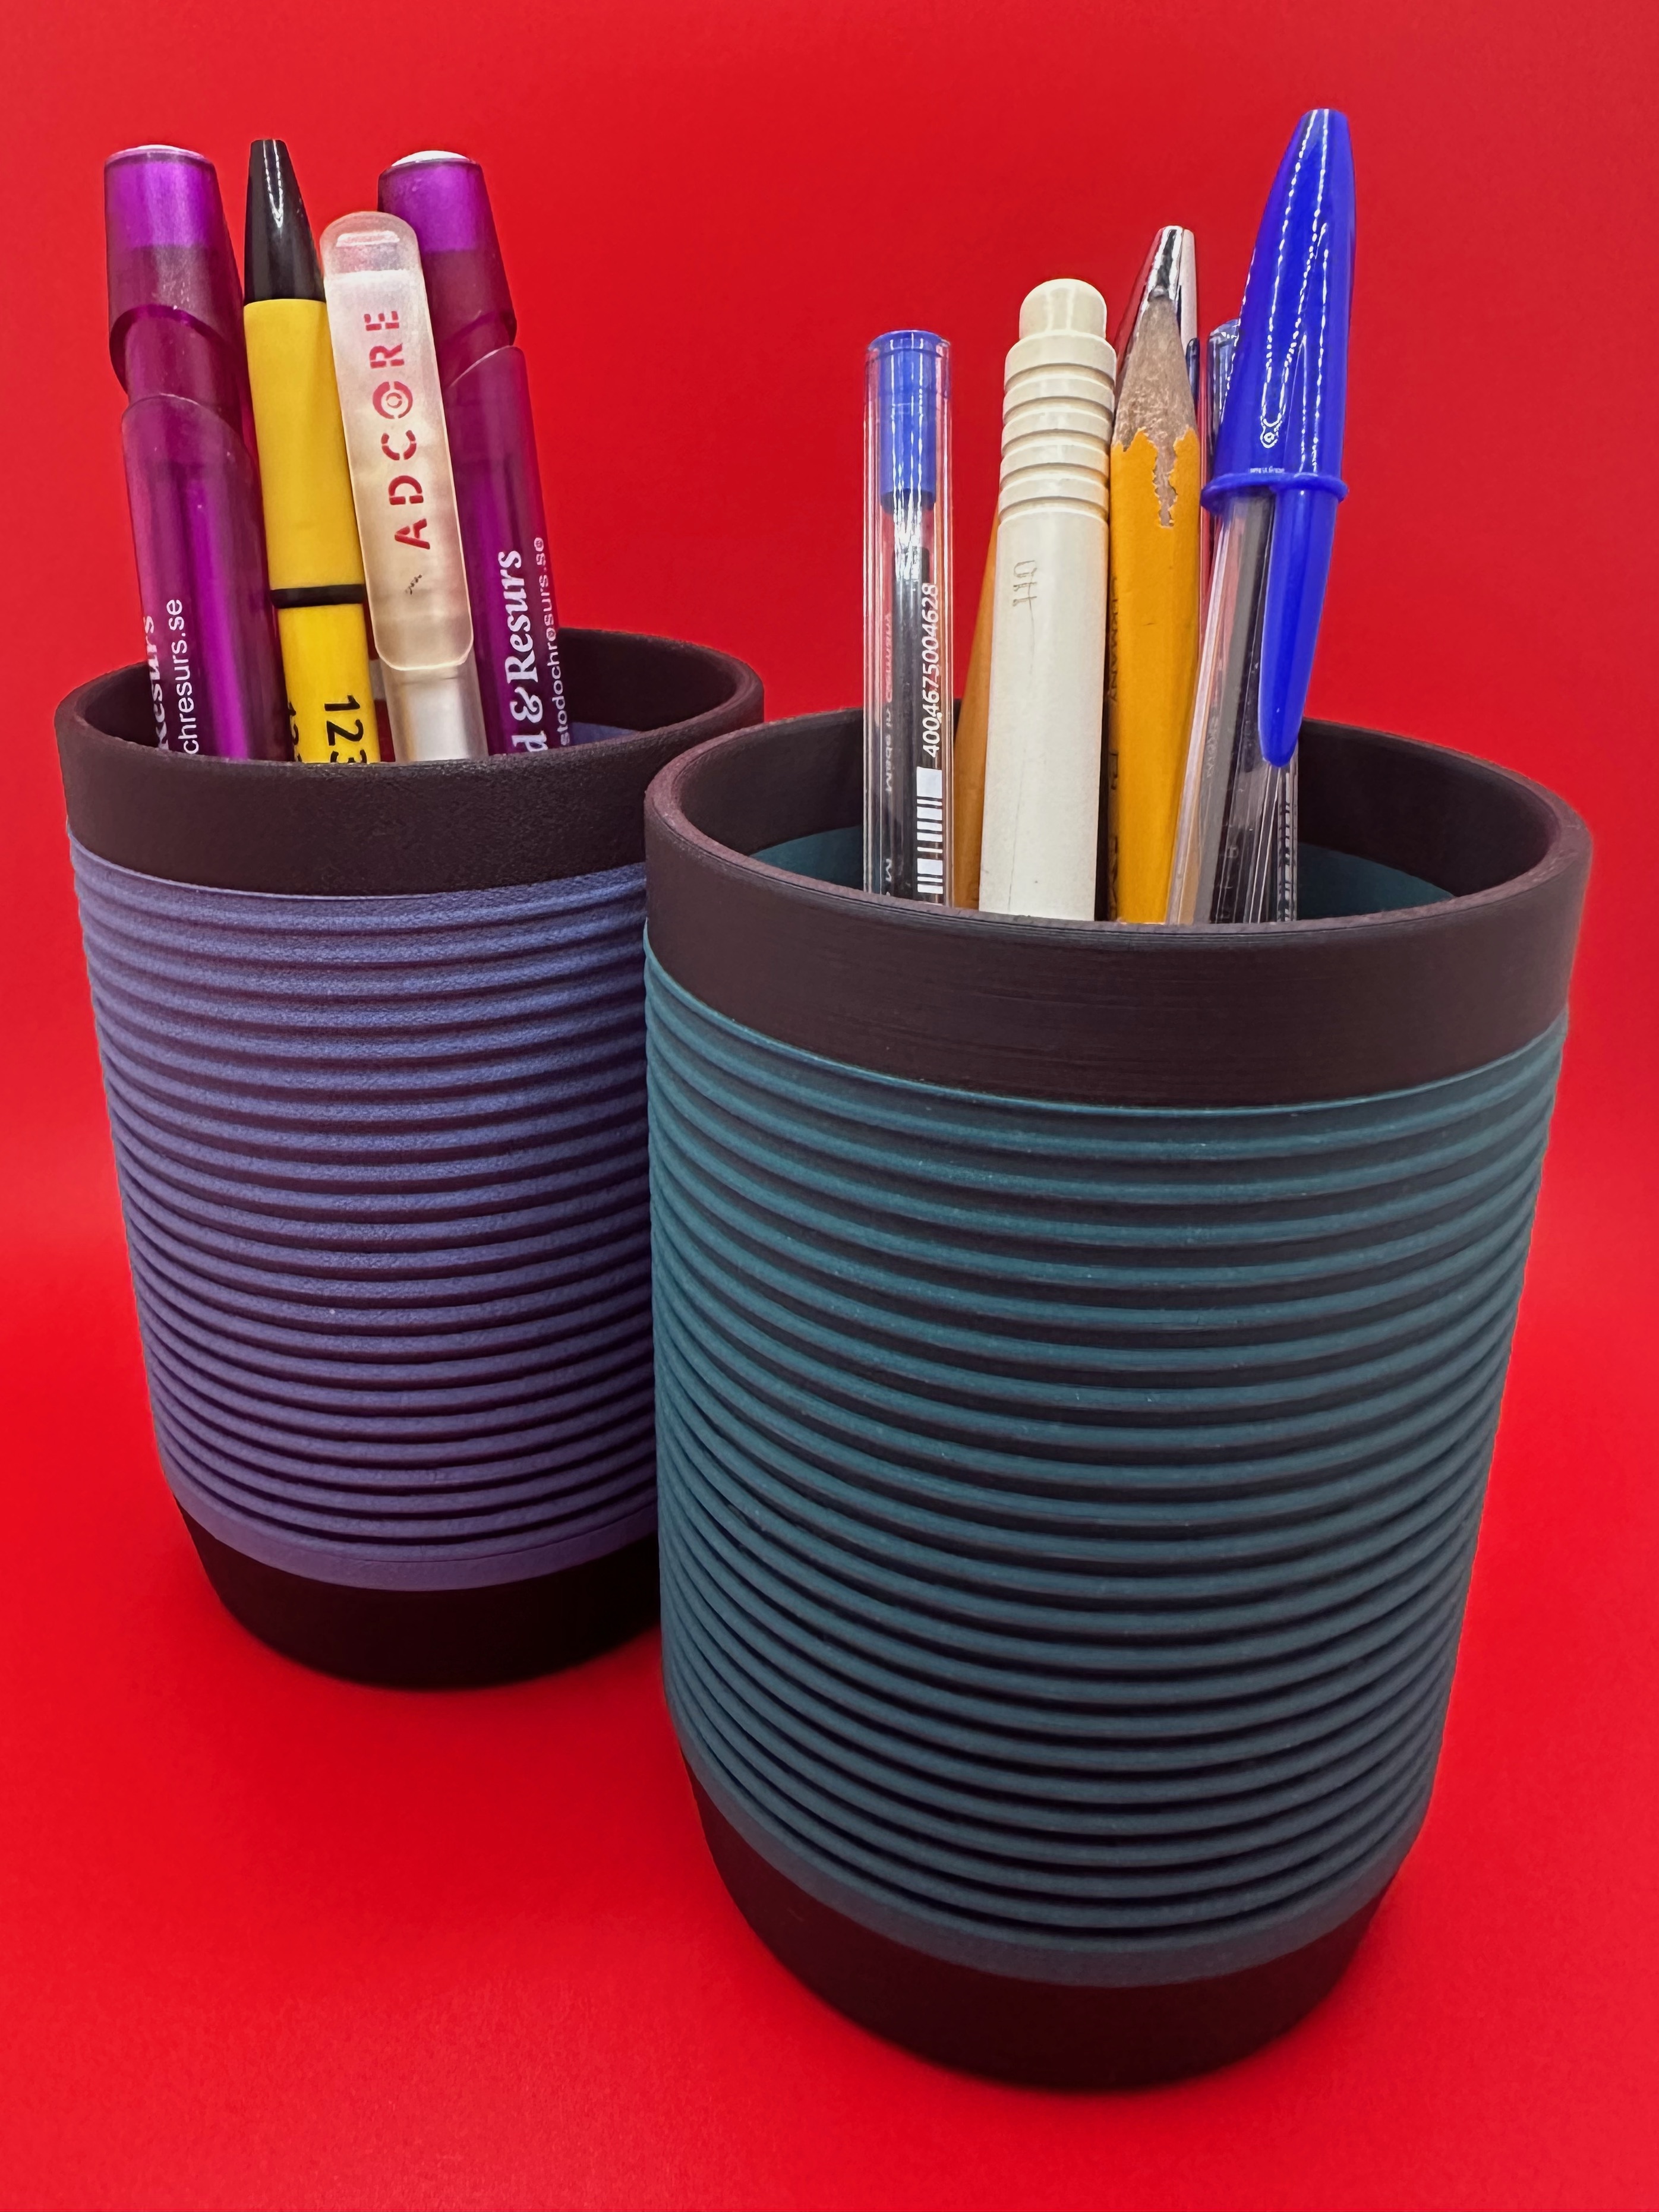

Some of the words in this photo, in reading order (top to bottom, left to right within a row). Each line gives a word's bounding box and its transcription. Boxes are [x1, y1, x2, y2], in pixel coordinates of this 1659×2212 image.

[364, 310, 430, 550] ADCORE
[165, 598, 198, 755] chresurs.se
[498, 550, 538, 684] Resurs
[922, 583, 940, 758] 4004675004628
[509, 687, 543, 724] &
